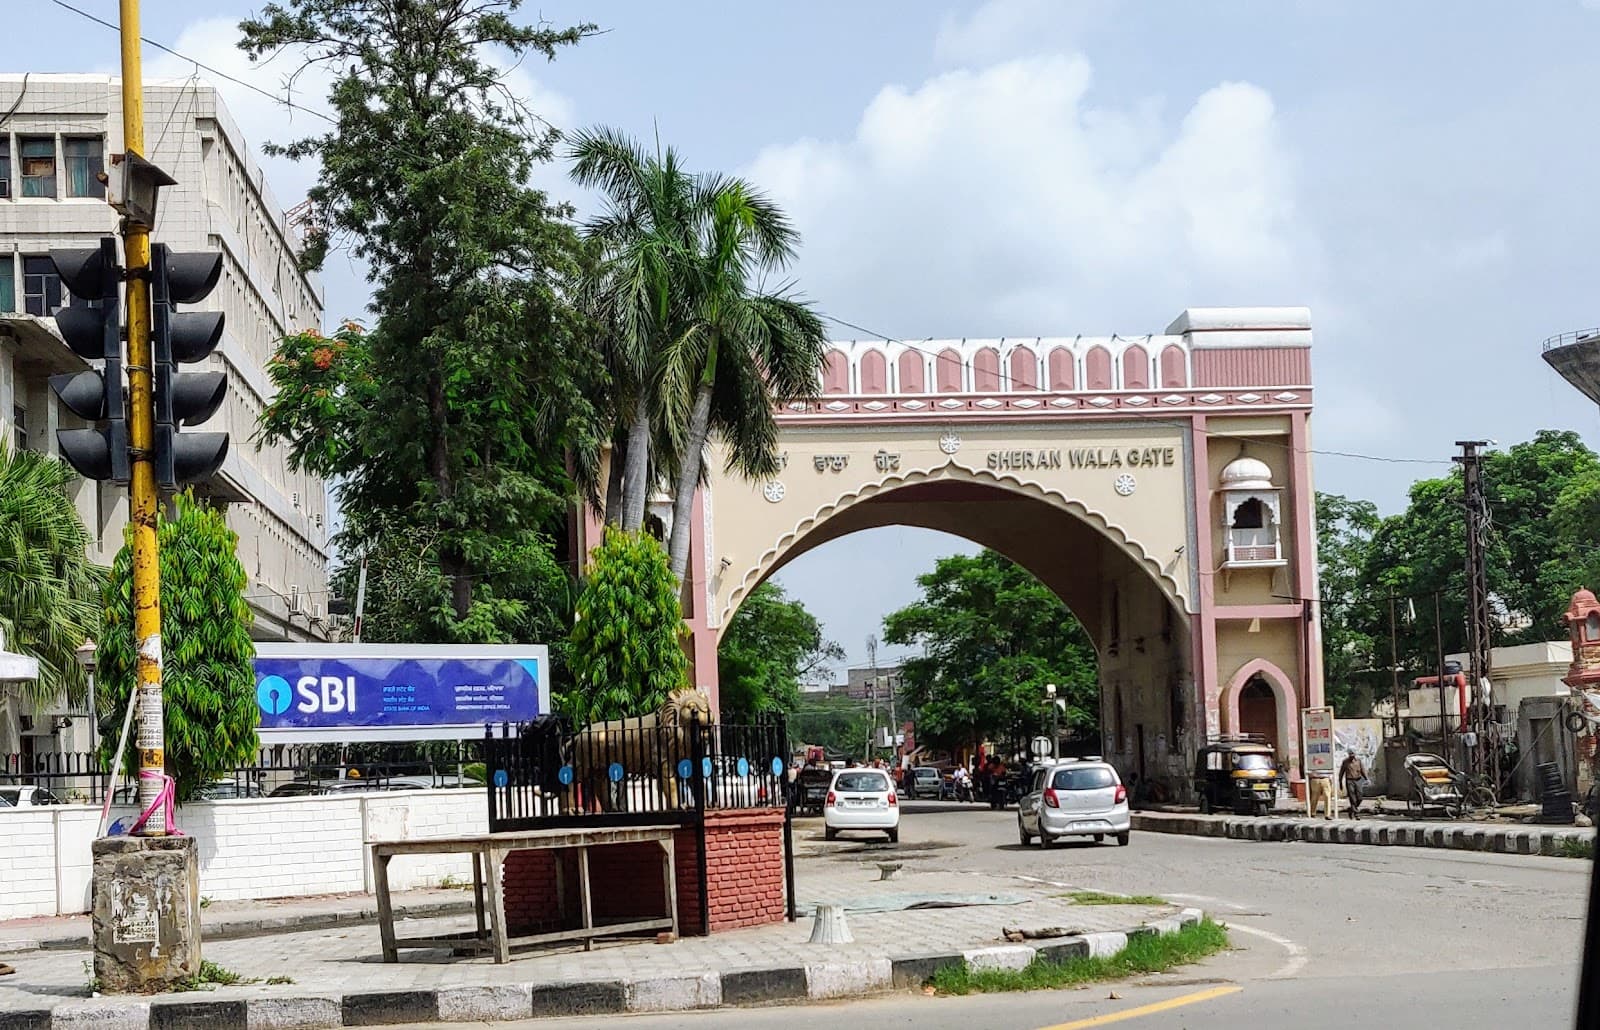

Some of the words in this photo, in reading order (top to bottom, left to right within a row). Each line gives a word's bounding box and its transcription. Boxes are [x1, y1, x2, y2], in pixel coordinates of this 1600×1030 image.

[813, 454, 850, 473] ਵਾਲਾ
[874, 449, 901, 473] ਗੇਟ
[987, 450, 1061, 470] SHERAN
[1069, 449, 1122, 469] WALA
[1127, 447, 1175, 467] GATE
[297, 676, 356, 714] SBI
